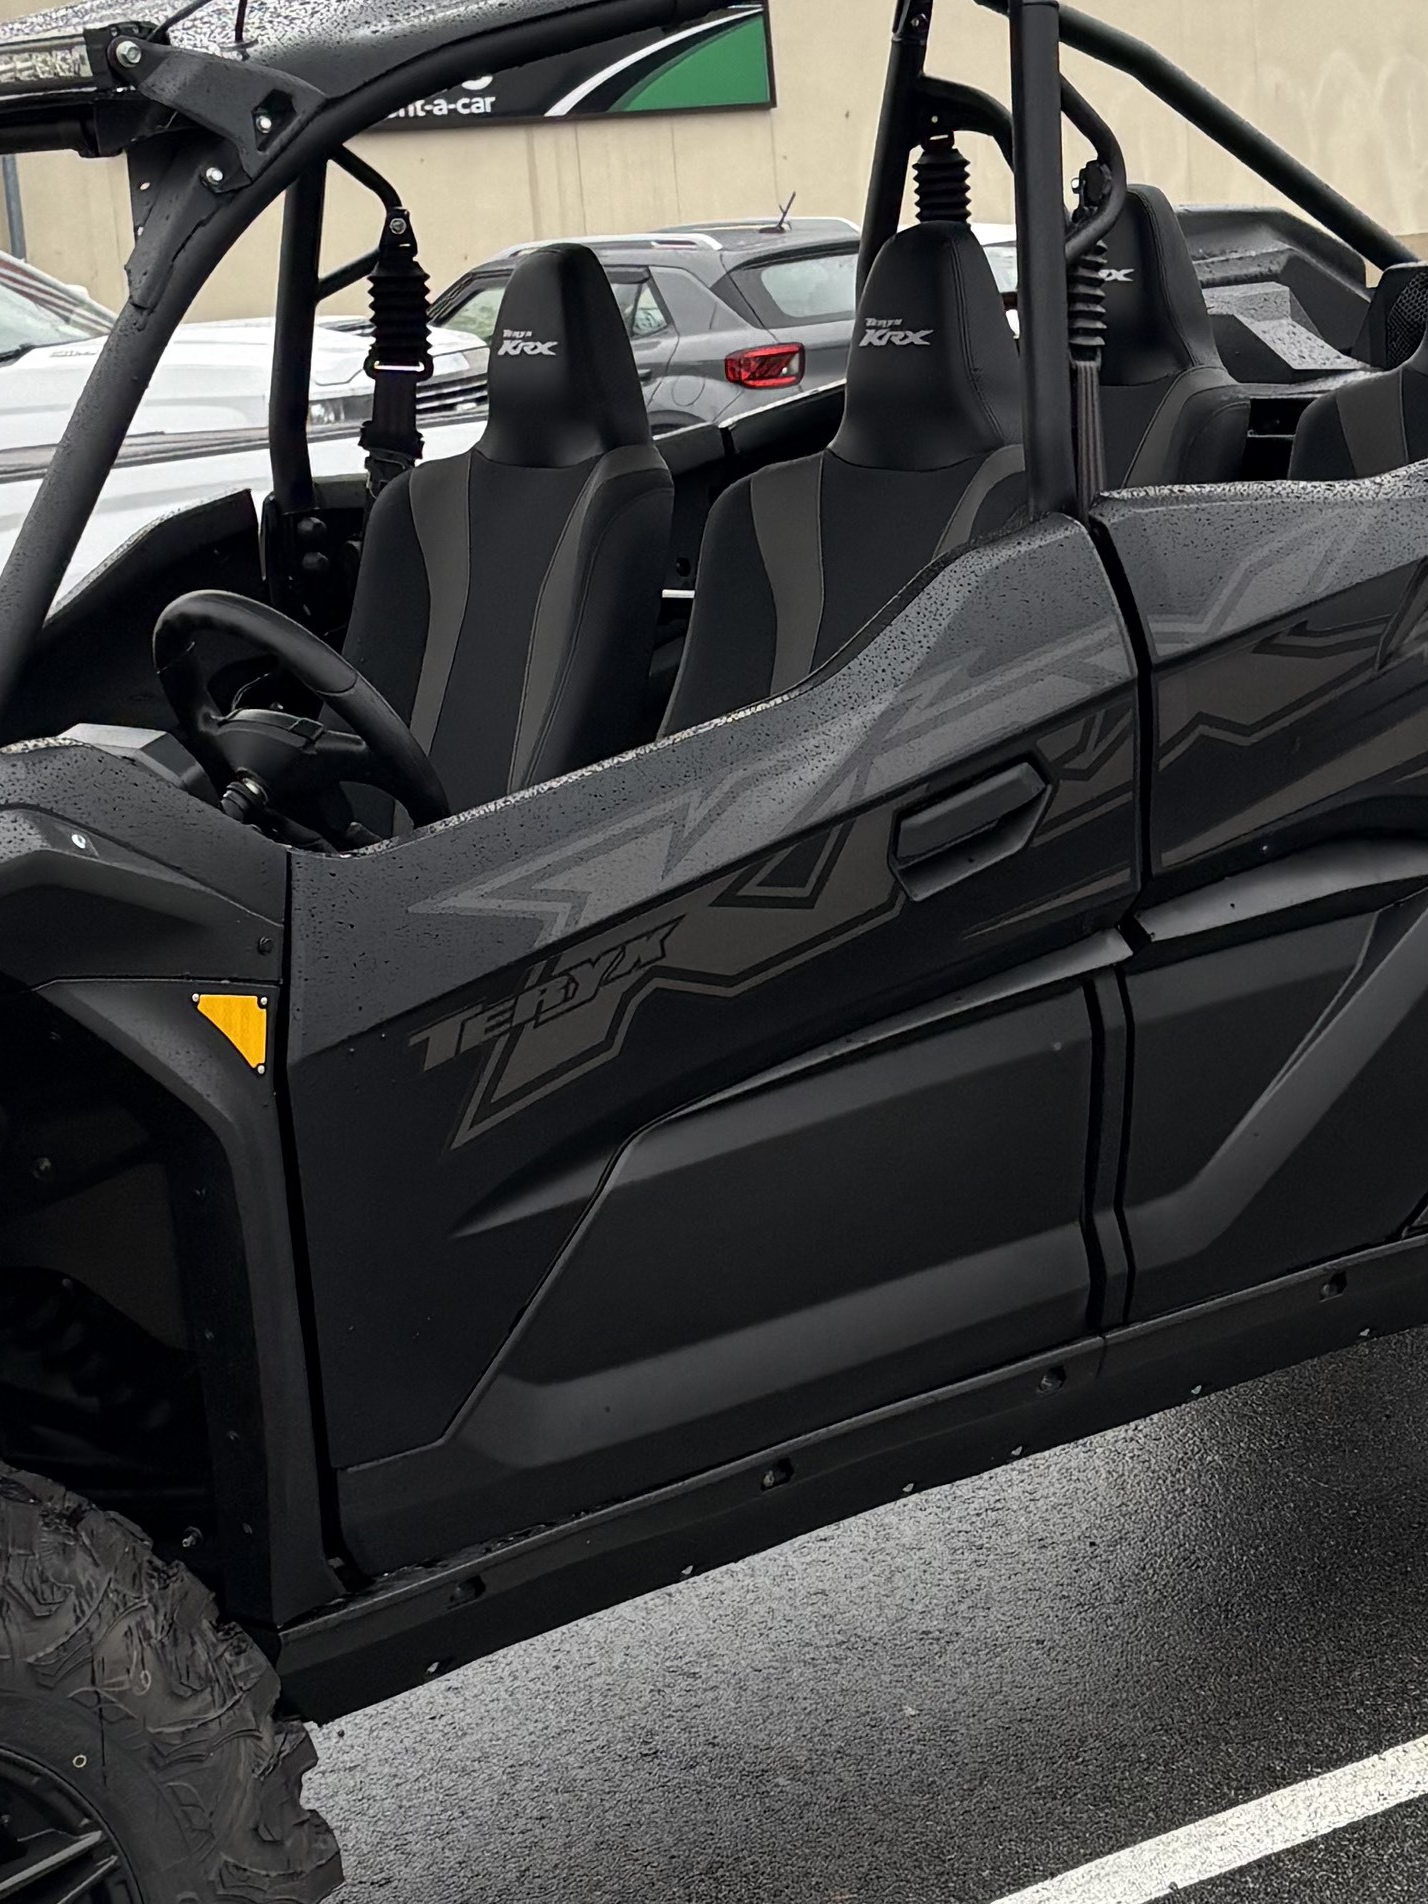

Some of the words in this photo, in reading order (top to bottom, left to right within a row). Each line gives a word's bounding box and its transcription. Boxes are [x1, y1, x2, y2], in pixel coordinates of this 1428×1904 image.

[858, 328, 934, 347] KRX
[497, 339, 559, 356] KRX
[408, 913, 686, 1073] TERYX
